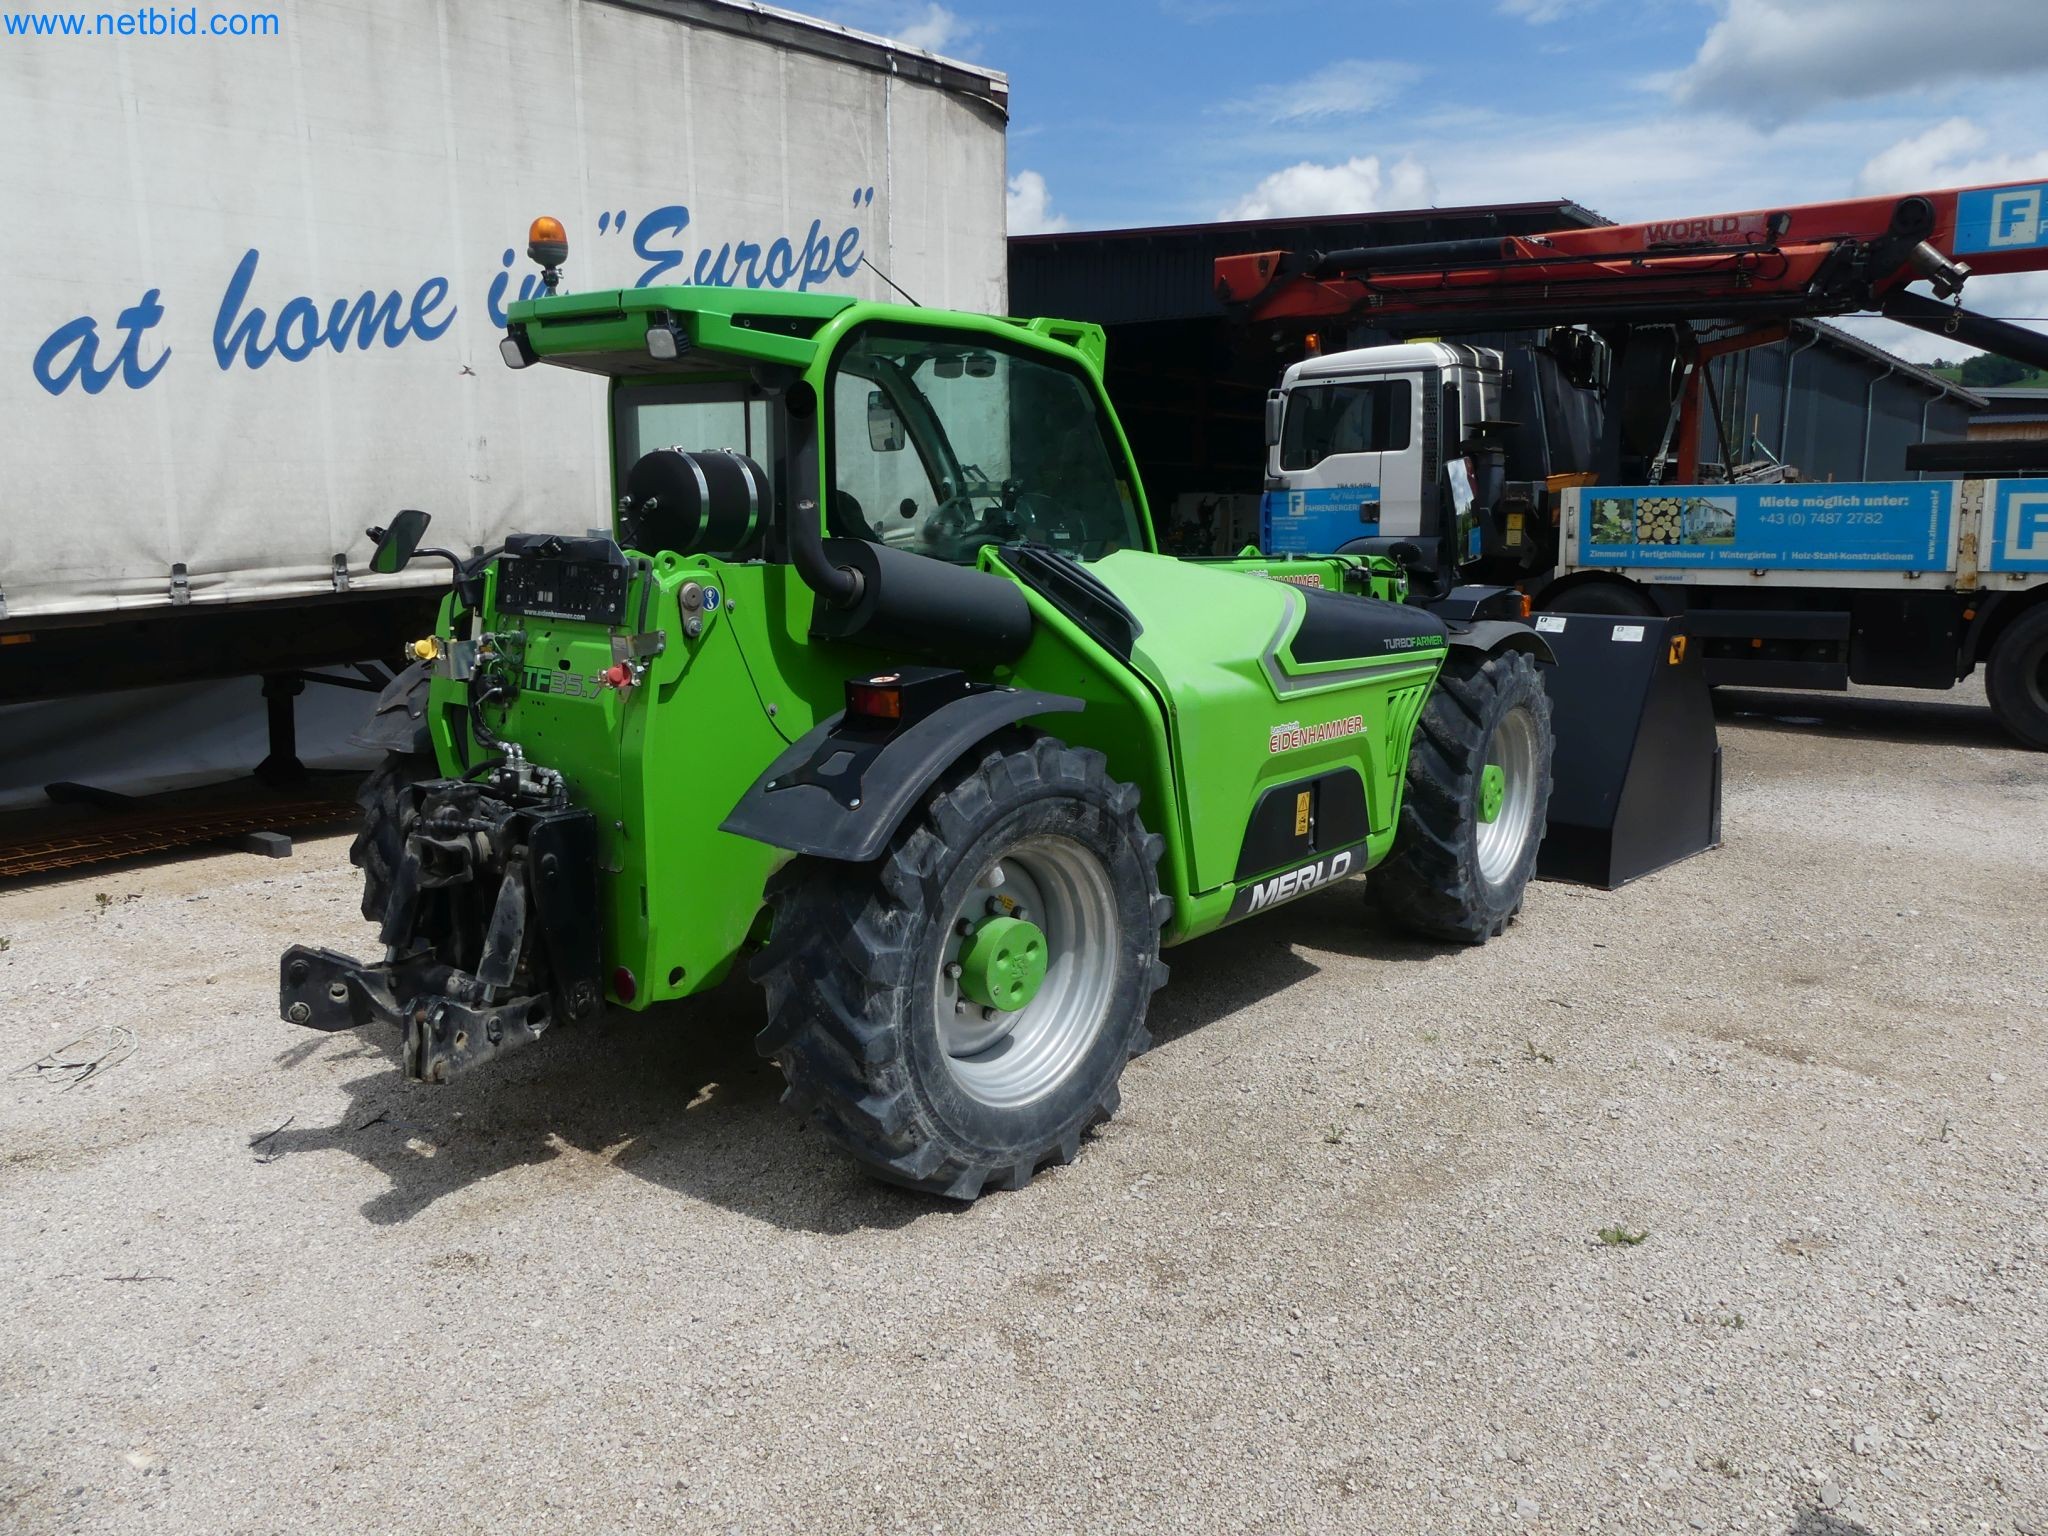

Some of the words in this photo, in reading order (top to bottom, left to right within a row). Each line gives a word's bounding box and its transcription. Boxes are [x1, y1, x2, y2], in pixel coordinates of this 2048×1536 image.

[1646, 215, 1740, 243] WORLD
[33, 288, 172, 396] at
[213, 248, 458, 371] home
[1759, 496, 1799, 507] Miete
[1803, 495, 1858, 509] möglich
[1863, 496, 1909, 507] unter:
[1759, 513, 1785, 525] +43
[1788, 513, 1806, 526] (0)
[1810, 512, 1842, 525] 7487
[1846, 512, 1883, 525] 2782
[1590, 550, 1627, 559] Zimmerei
[1719, 551, 1777, 561] Wintergärten
[1383, 635, 1444, 650] TURBOFARMER
[1269, 715, 1363, 754] EIDENHAMMER
[1247, 851, 1352, 913] MERLO
